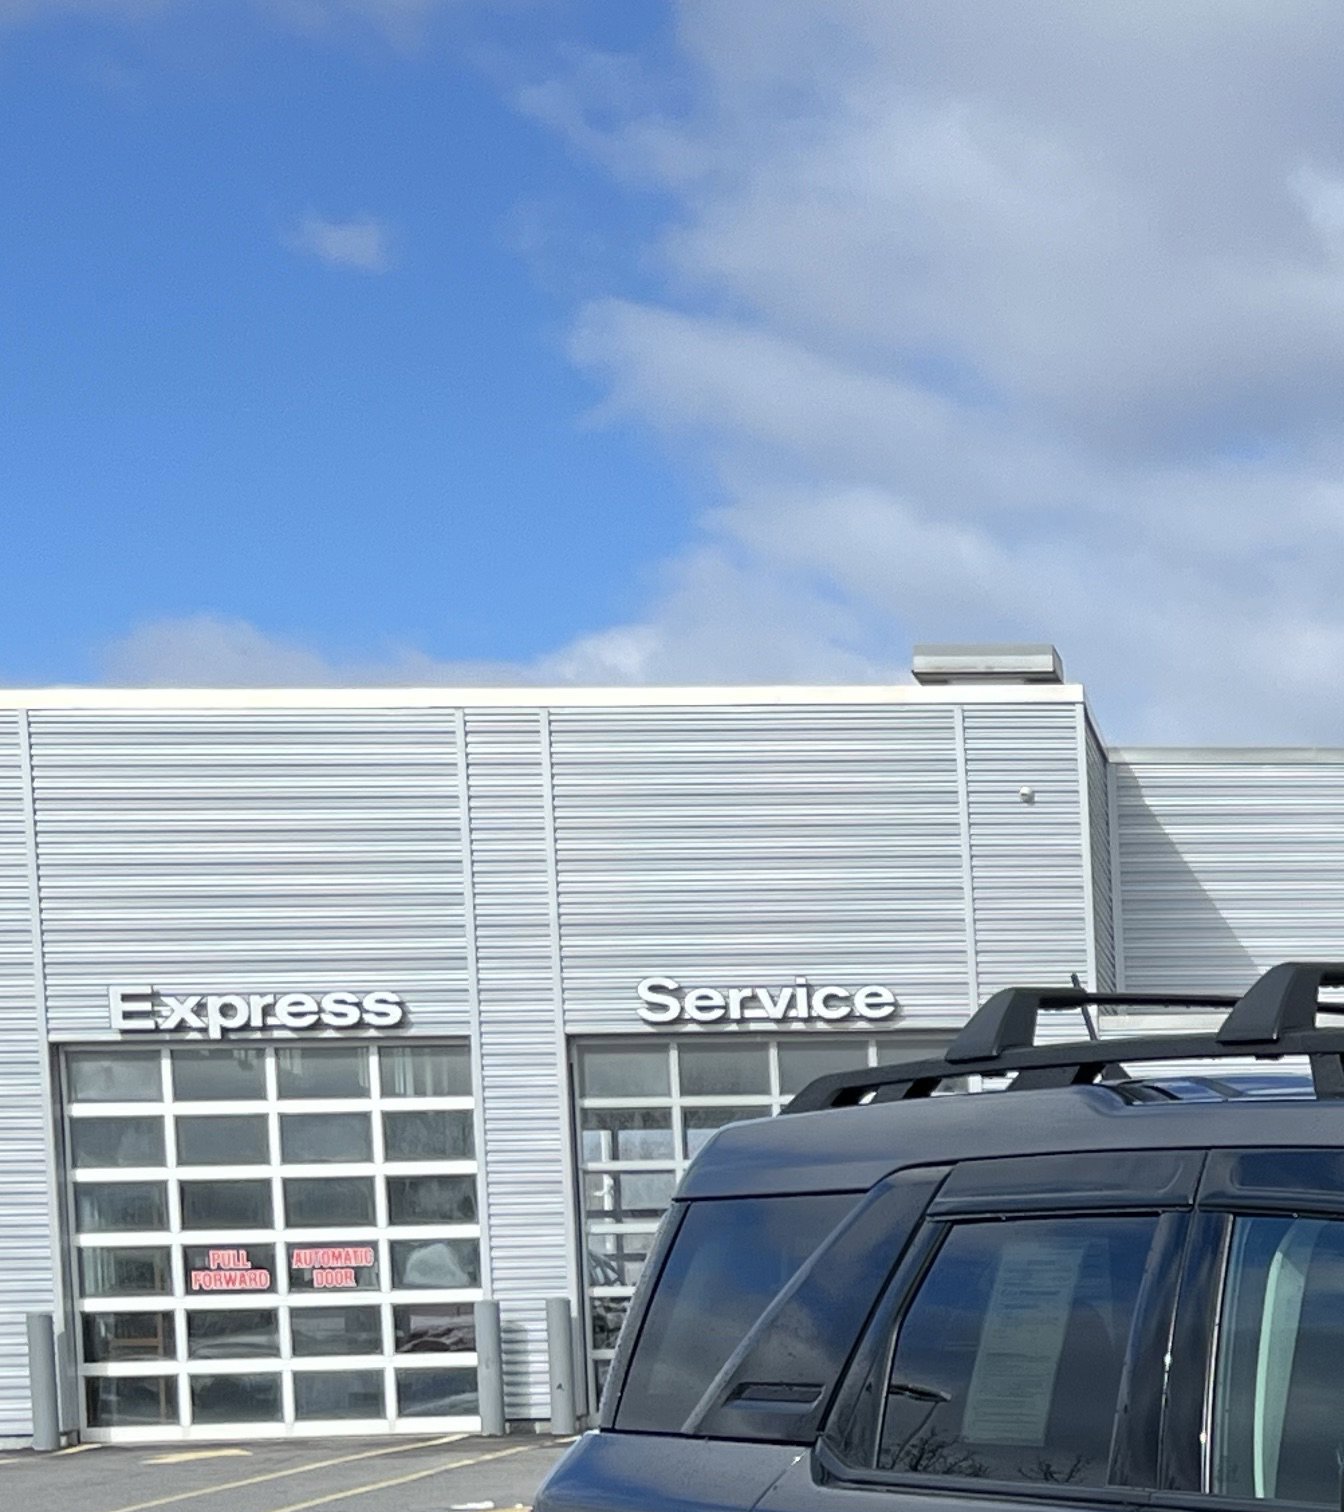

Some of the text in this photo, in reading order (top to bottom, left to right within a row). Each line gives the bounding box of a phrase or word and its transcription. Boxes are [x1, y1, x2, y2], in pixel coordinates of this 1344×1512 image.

[637, 976, 896, 1022] Service
[108, 985, 403, 1040] Express
[209, 1250, 251, 1268] PULL
[291, 1247, 374, 1268] AUTOMATIC
[191, 1269, 270, 1290] FORWARD
[313, 1268, 357, 1288] DOOR
